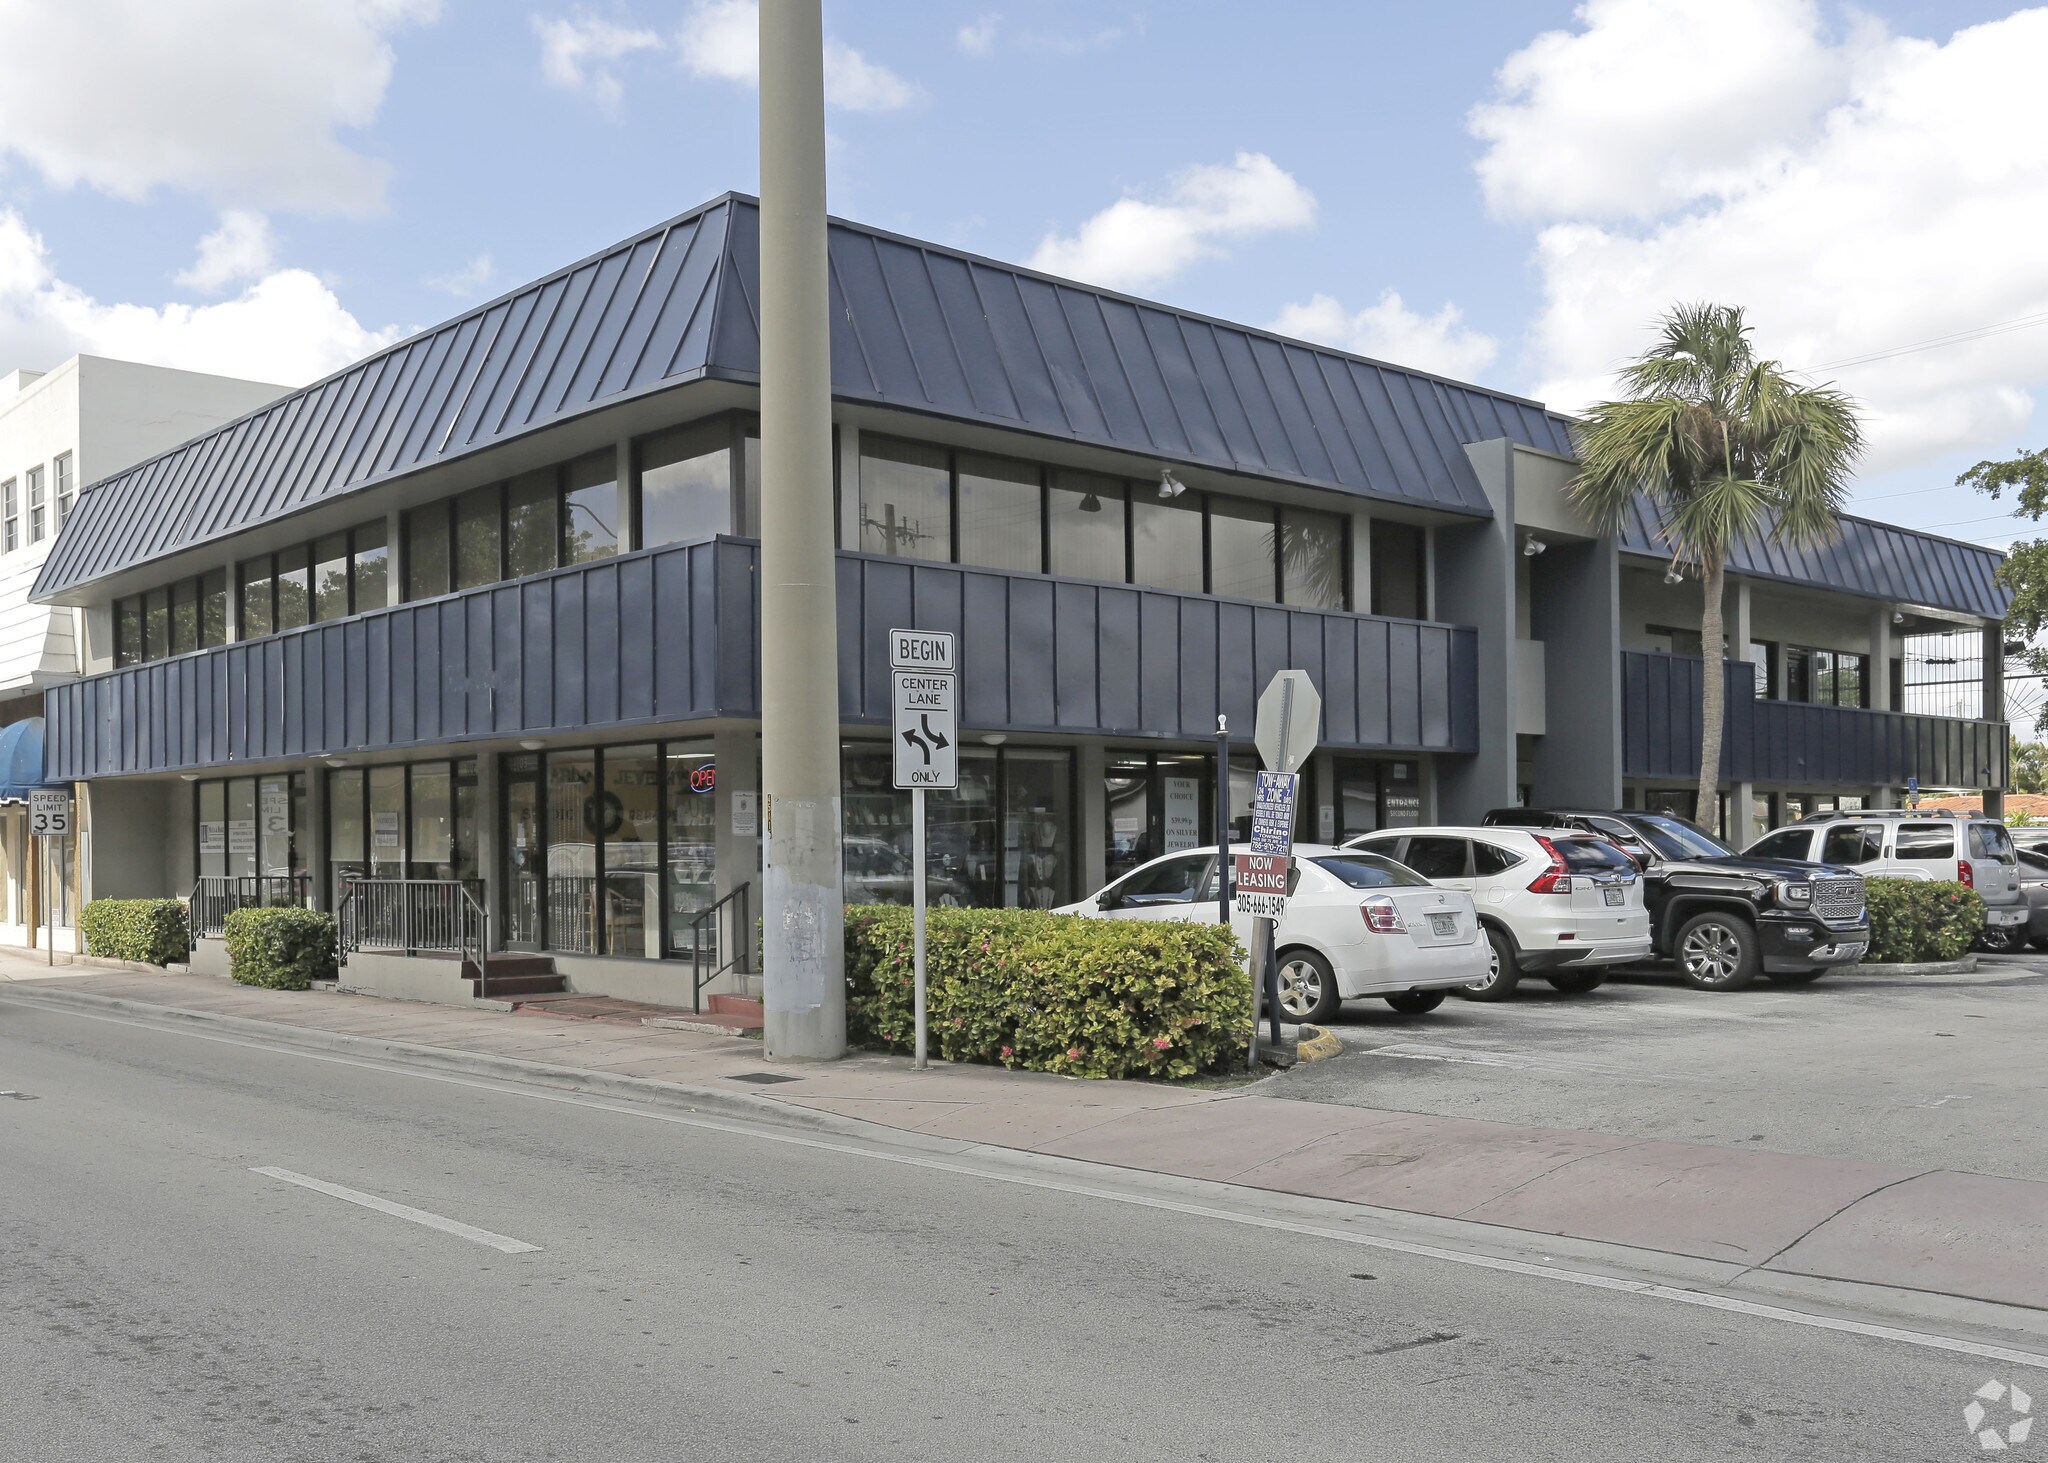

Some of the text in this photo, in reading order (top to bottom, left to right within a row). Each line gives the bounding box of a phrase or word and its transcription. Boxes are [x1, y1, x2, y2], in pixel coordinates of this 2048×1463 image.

[900, 638, 946, 661] BEGIN
[901, 678, 948, 691] CENTER
[908, 693, 941, 705] LANE
[911, 771, 941, 783] ONLY
[33, 794, 66, 802] SPEED
[1169, 792, 1193, 800] CHOICE
[1267, 788, 1281, 802] ZONE
[1386, 798, 1419, 808] ENTRANCE
[34, 813, 66, 830] 35
[1254, 826, 1288, 836] Chirino
[1249, 856, 1273, 870] NOW
[1238, 871, 1285, 889] LEASING
[1237, 893, 1284, 916] 305-666-1549
